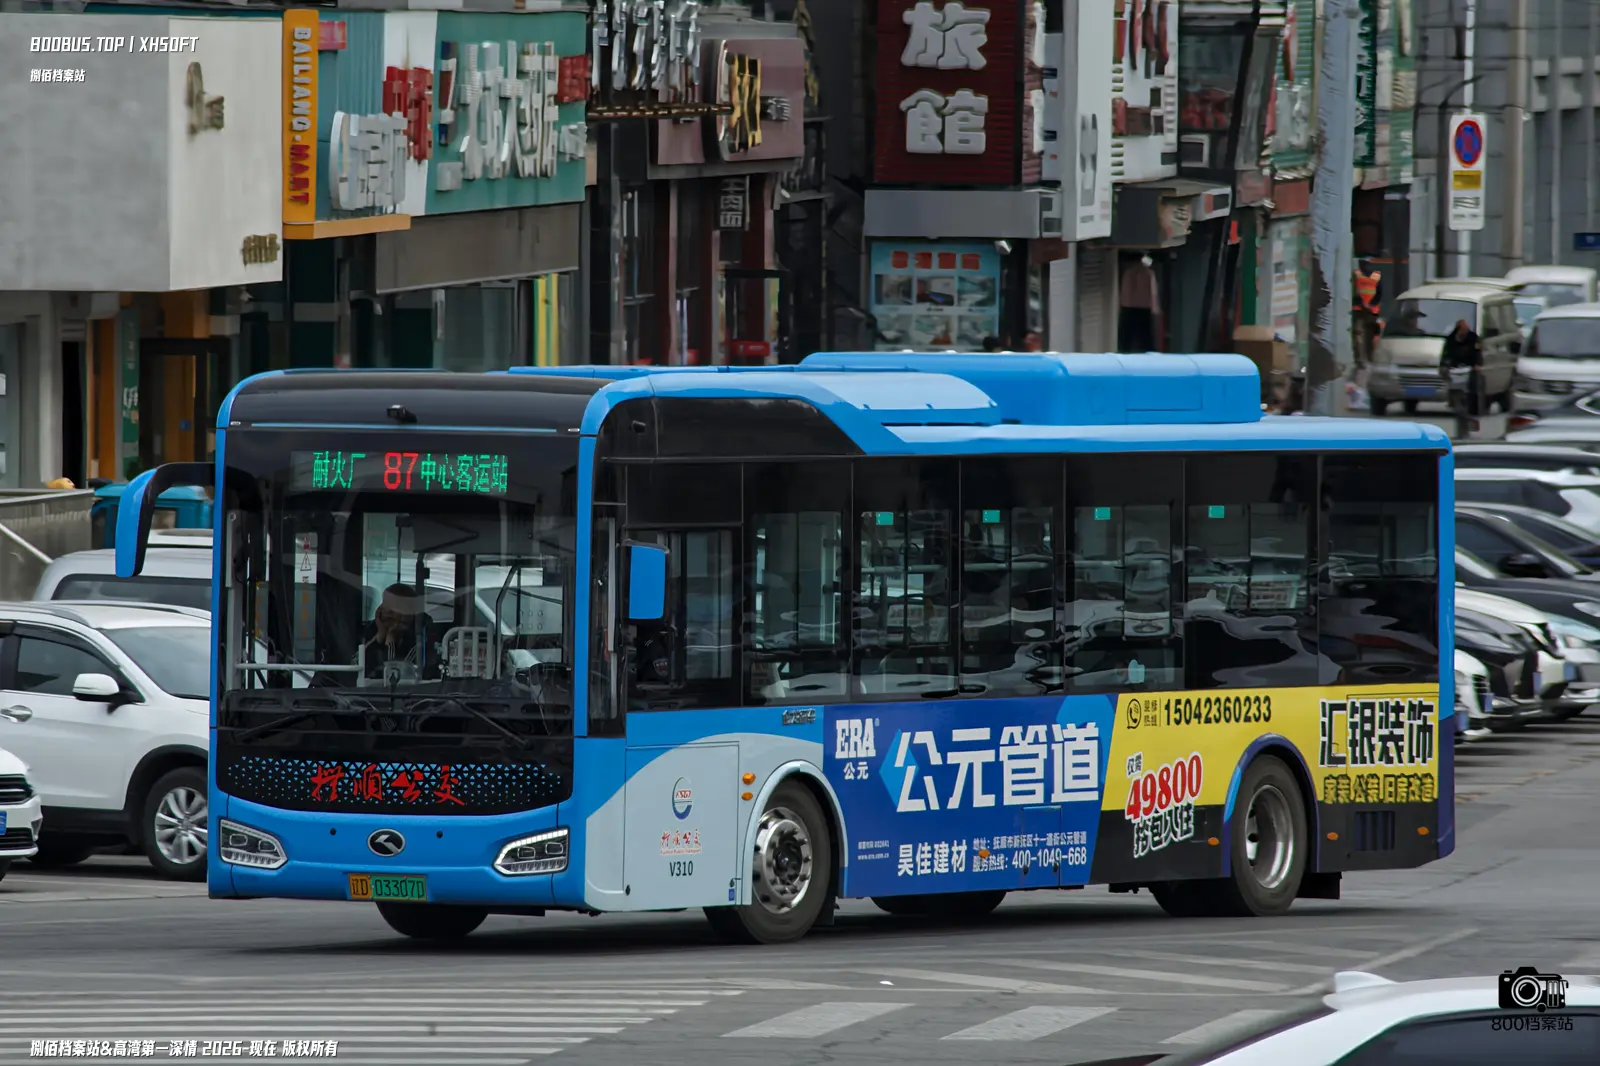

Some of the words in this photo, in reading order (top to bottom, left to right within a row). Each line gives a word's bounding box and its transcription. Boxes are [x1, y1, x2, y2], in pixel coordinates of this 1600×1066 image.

[312, 451, 367, 488] 耐火厂
[383, 452, 419, 490] 87
[420, 453, 508, 493] 中心客运站
[1164, 695, 1272, 726] 15042360233
[835, 718, 876, 759] ERA
[1319, 698, 1436, 768] 汇银装饰
[843, 762, 869, 780] 公元
[894, 721, 1099, 813] 公元管道
[1125, 753, 1203, 821] 49800
[1134, 803, 1195, 857] 拎包入住
[669, 861, 694, 877] V310
[897, 840, 968, 876] 昊佳建材
[1011, 847, 1087, 869] 400-1049-668
